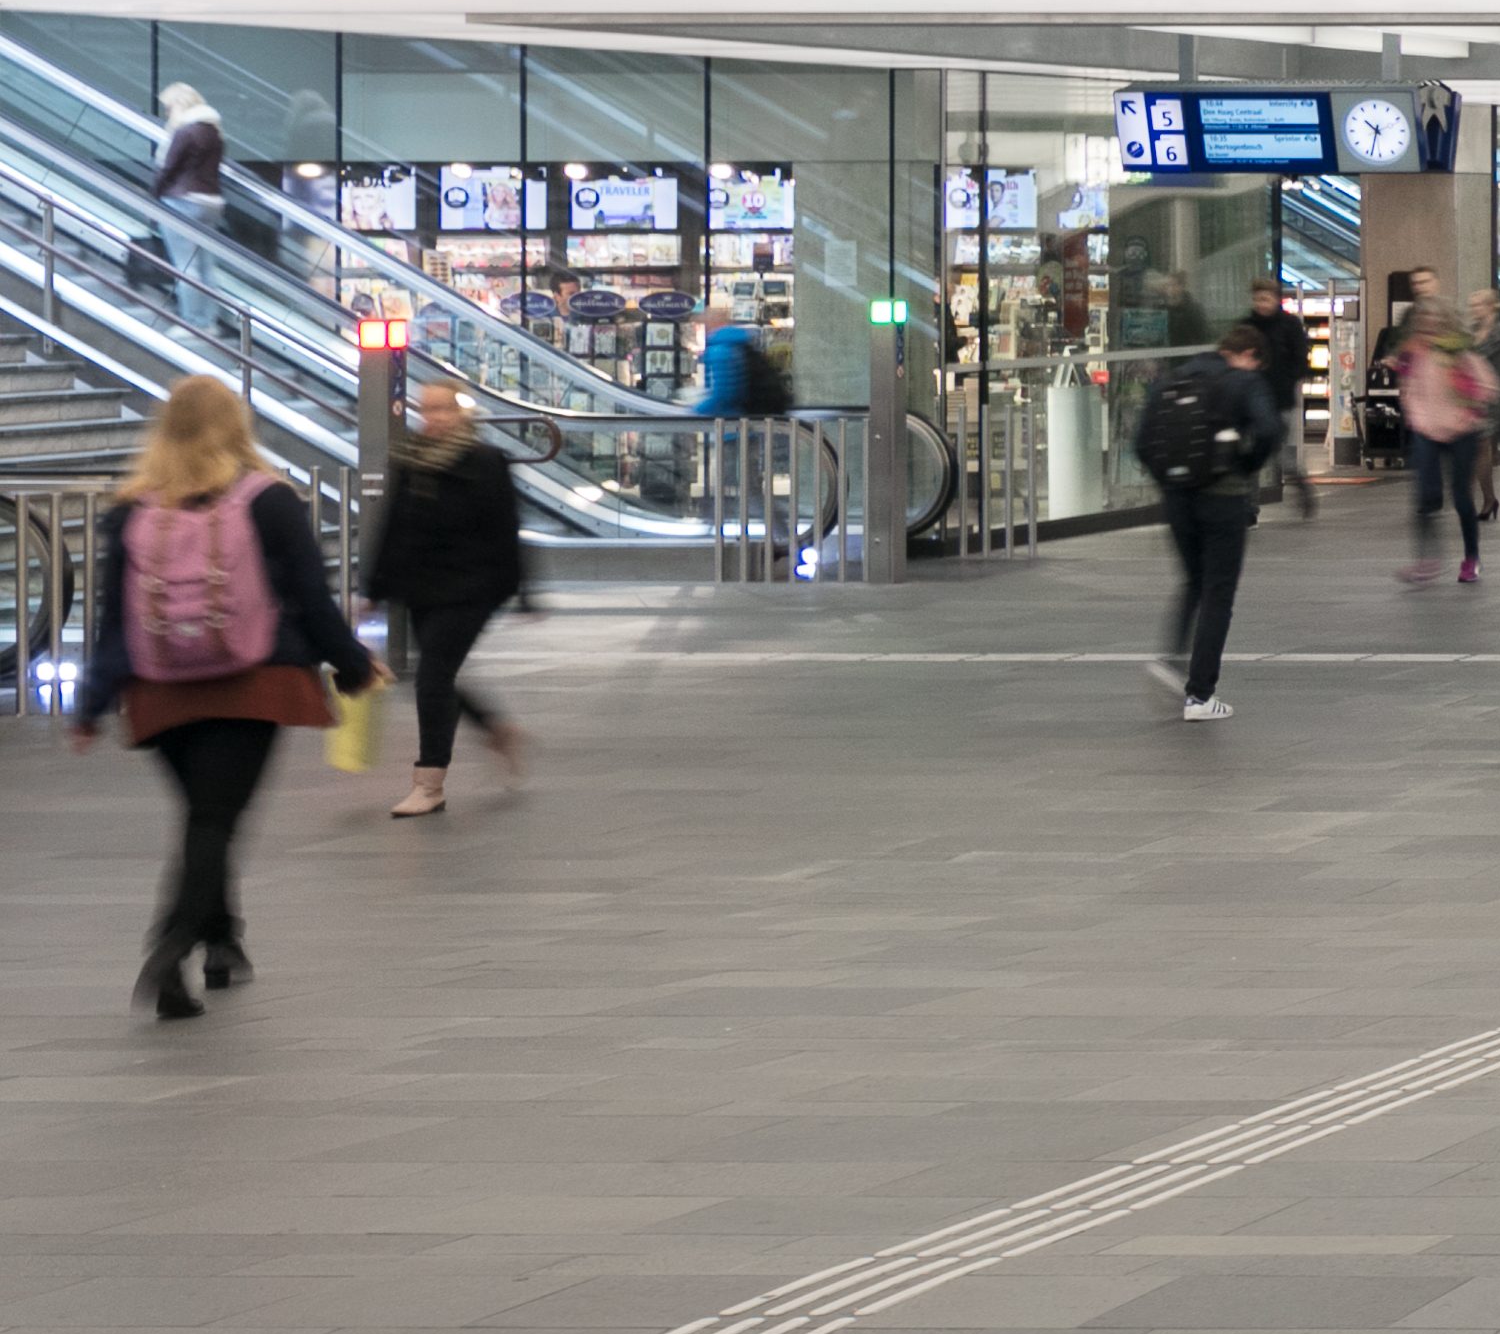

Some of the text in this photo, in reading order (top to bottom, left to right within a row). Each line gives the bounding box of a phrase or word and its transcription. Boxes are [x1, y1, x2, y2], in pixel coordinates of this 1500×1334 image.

[1162, 111, 1173, 127] 5
[1166, 146, 1177, 161] 6
[599, 186, 650, 197] TRAVELER
